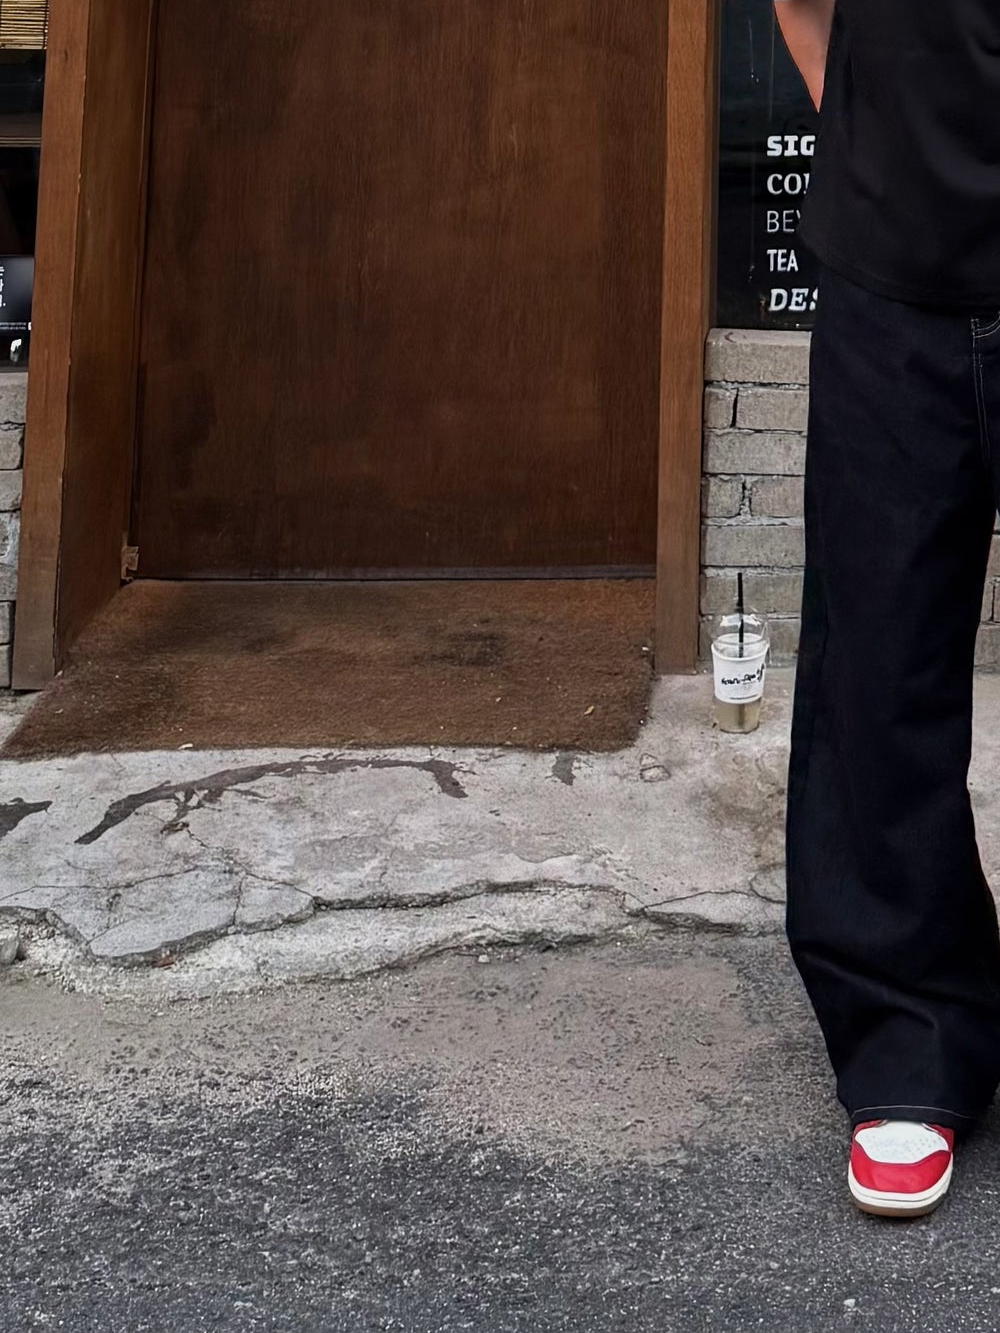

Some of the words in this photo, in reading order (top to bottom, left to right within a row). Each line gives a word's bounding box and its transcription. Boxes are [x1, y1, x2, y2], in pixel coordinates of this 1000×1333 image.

[766, 135, 816, 157] SIG
[766, 173, 810, 195] CO
[766, 210, 801, 233] BE
[766, 249, 799, 272] TEA
